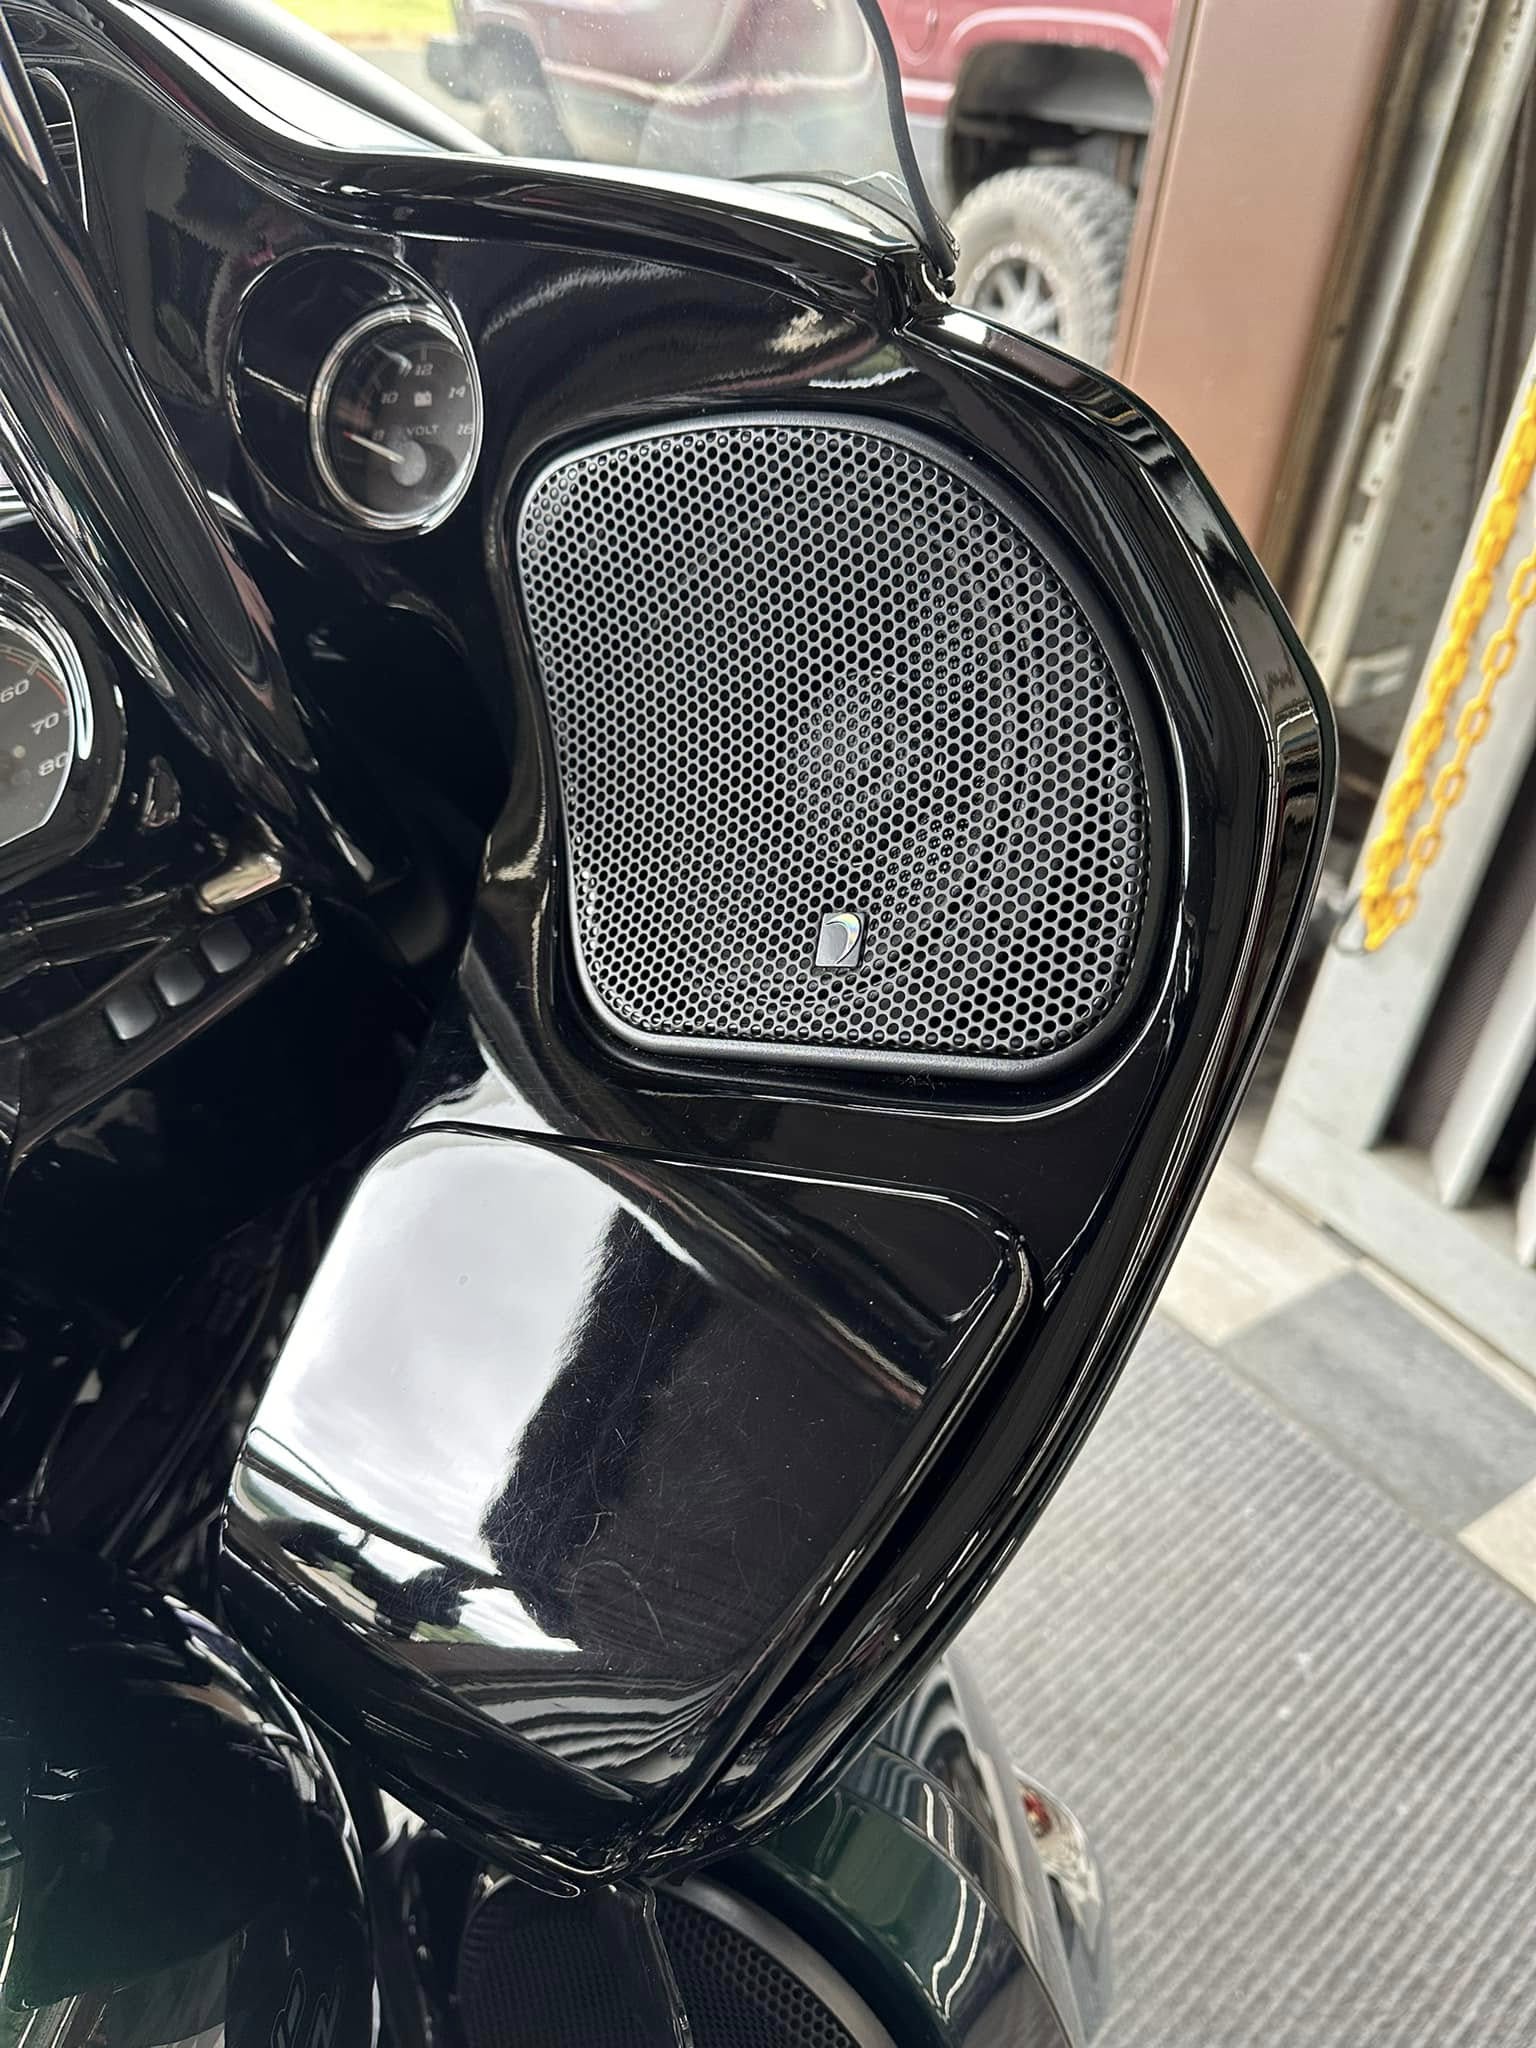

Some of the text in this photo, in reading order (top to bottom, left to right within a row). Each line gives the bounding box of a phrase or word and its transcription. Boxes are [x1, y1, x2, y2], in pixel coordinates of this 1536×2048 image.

[414, 363, 433, 376] 12
[381, 391, 399, 404] 10
[448, 385, 466, 399] 14
[406, 424, 439, 436] VOLT
[0, 679, 30, 703] 60
[30, 712, 60, 735] 70
[38, 751, 69, 776] 80
